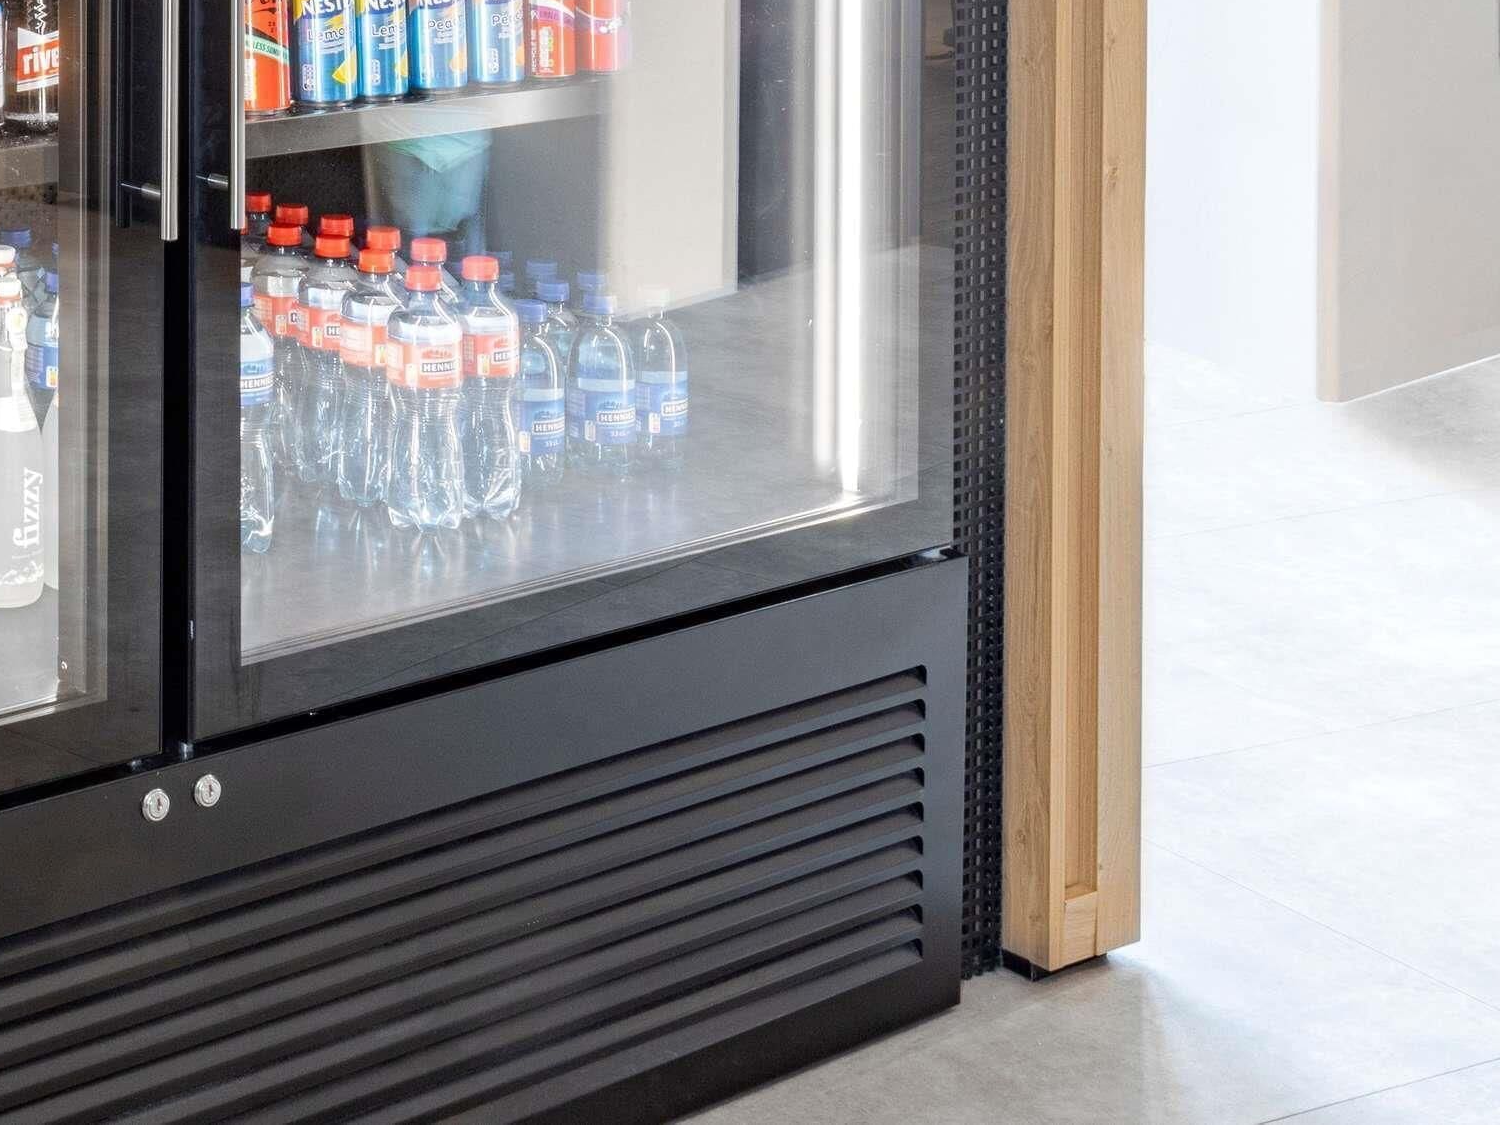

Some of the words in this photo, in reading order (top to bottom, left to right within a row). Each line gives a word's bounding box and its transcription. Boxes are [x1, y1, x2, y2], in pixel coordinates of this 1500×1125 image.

[307, 26, 346, 43] Lemo
[23, 47, 59, 75] rive
[13, 467, 44, 549] fizzy
